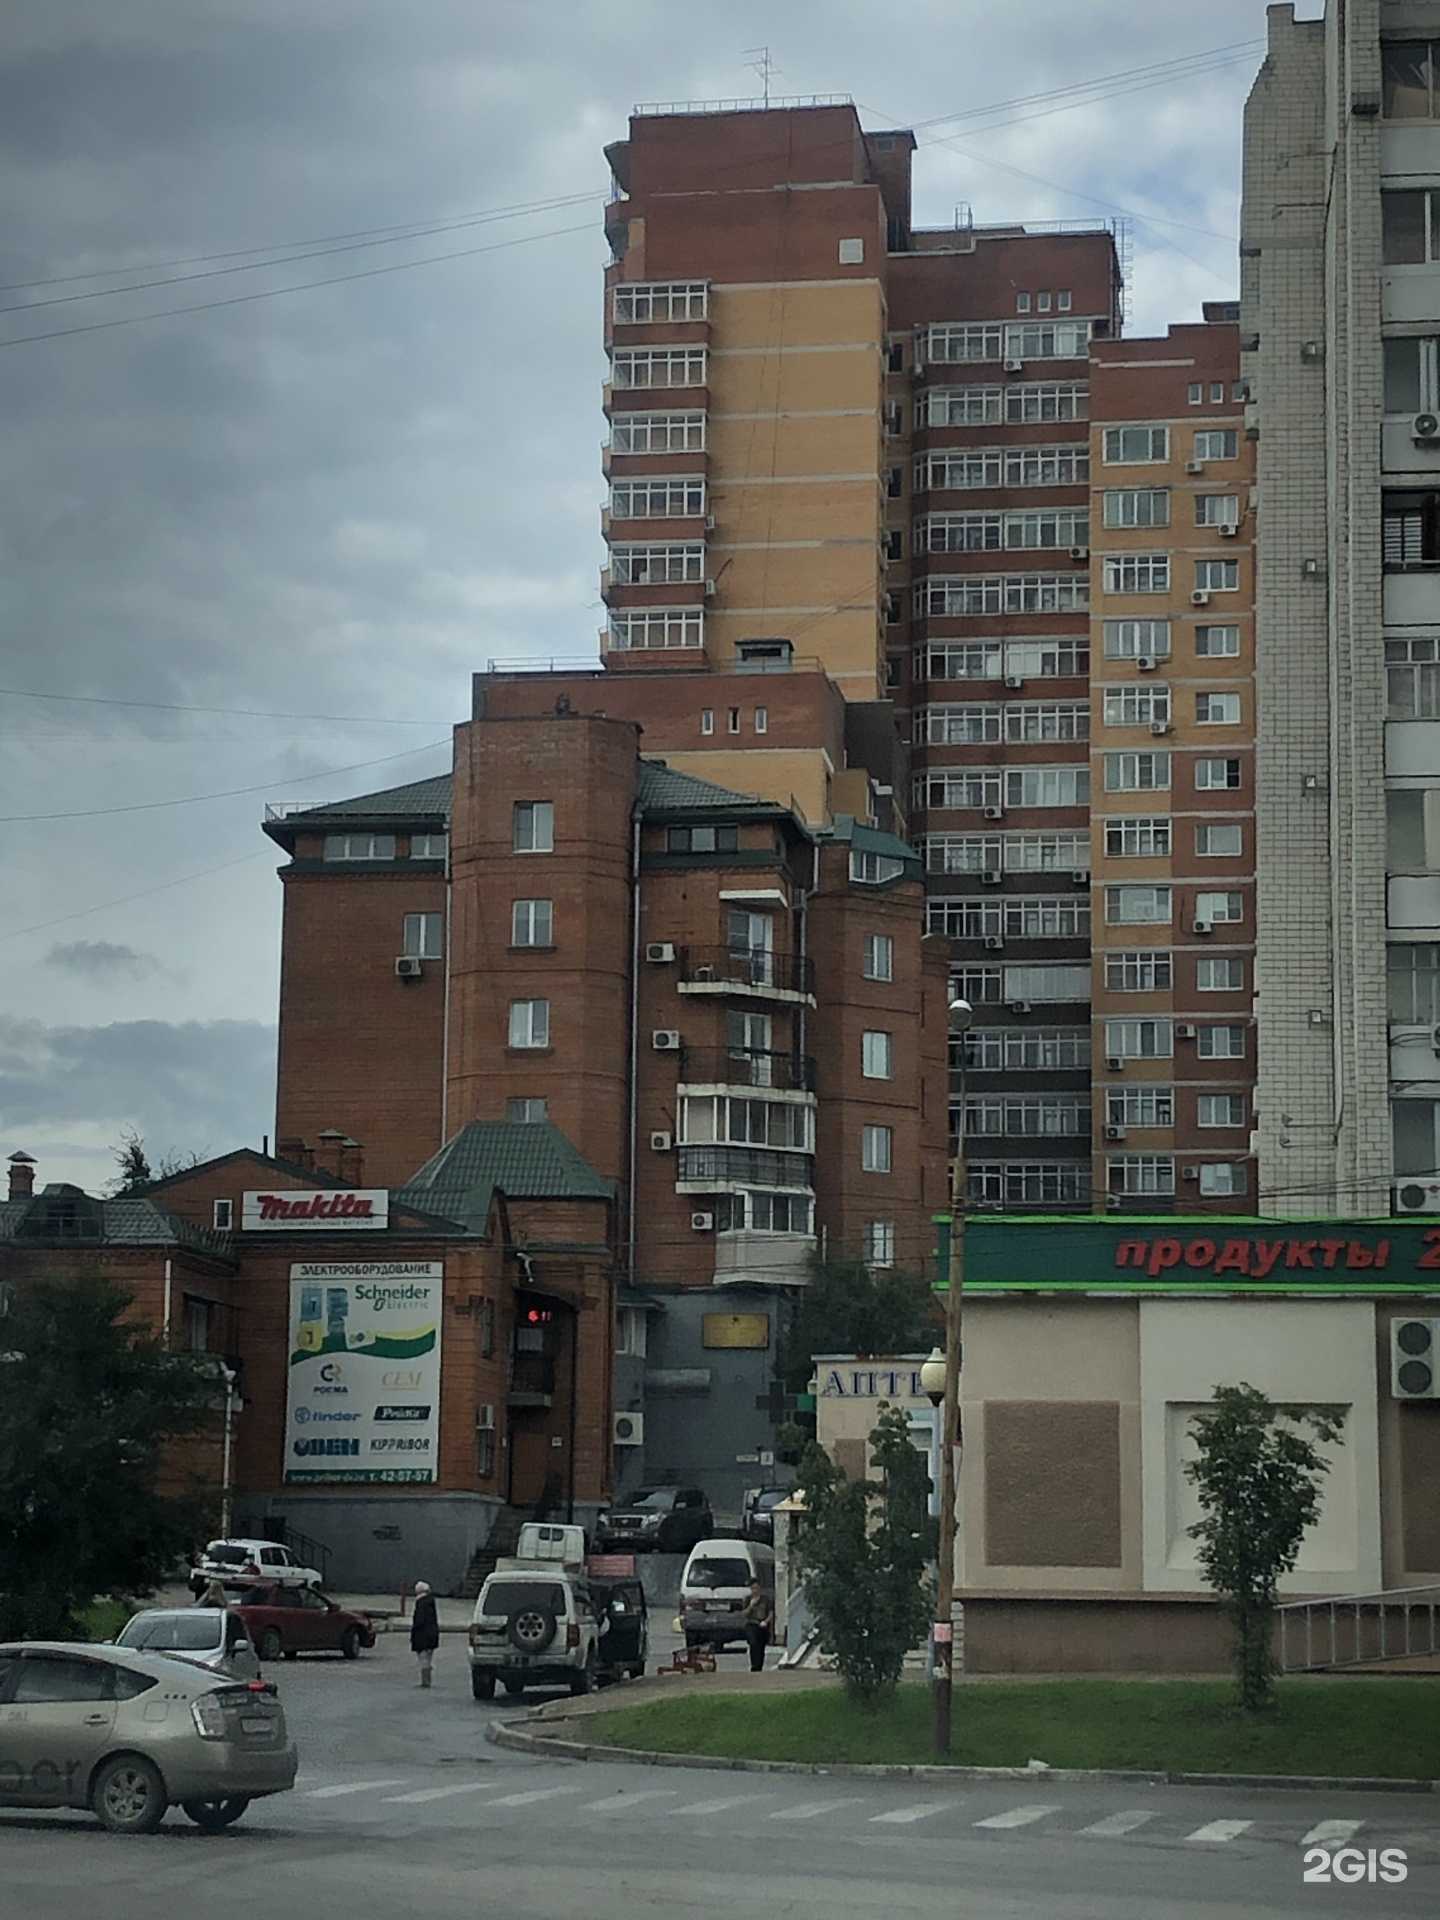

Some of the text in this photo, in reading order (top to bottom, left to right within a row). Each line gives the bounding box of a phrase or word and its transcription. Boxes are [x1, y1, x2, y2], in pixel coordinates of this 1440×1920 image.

[1115, 1238, 1390, 1277] продукты
[300, 1264, 431, 1275] ЭЛЕКТРООБОРУДОВАНИЕ
[355, 1284, 430, 1299] Schneider
[312, 1411, 361, 1421] finder
